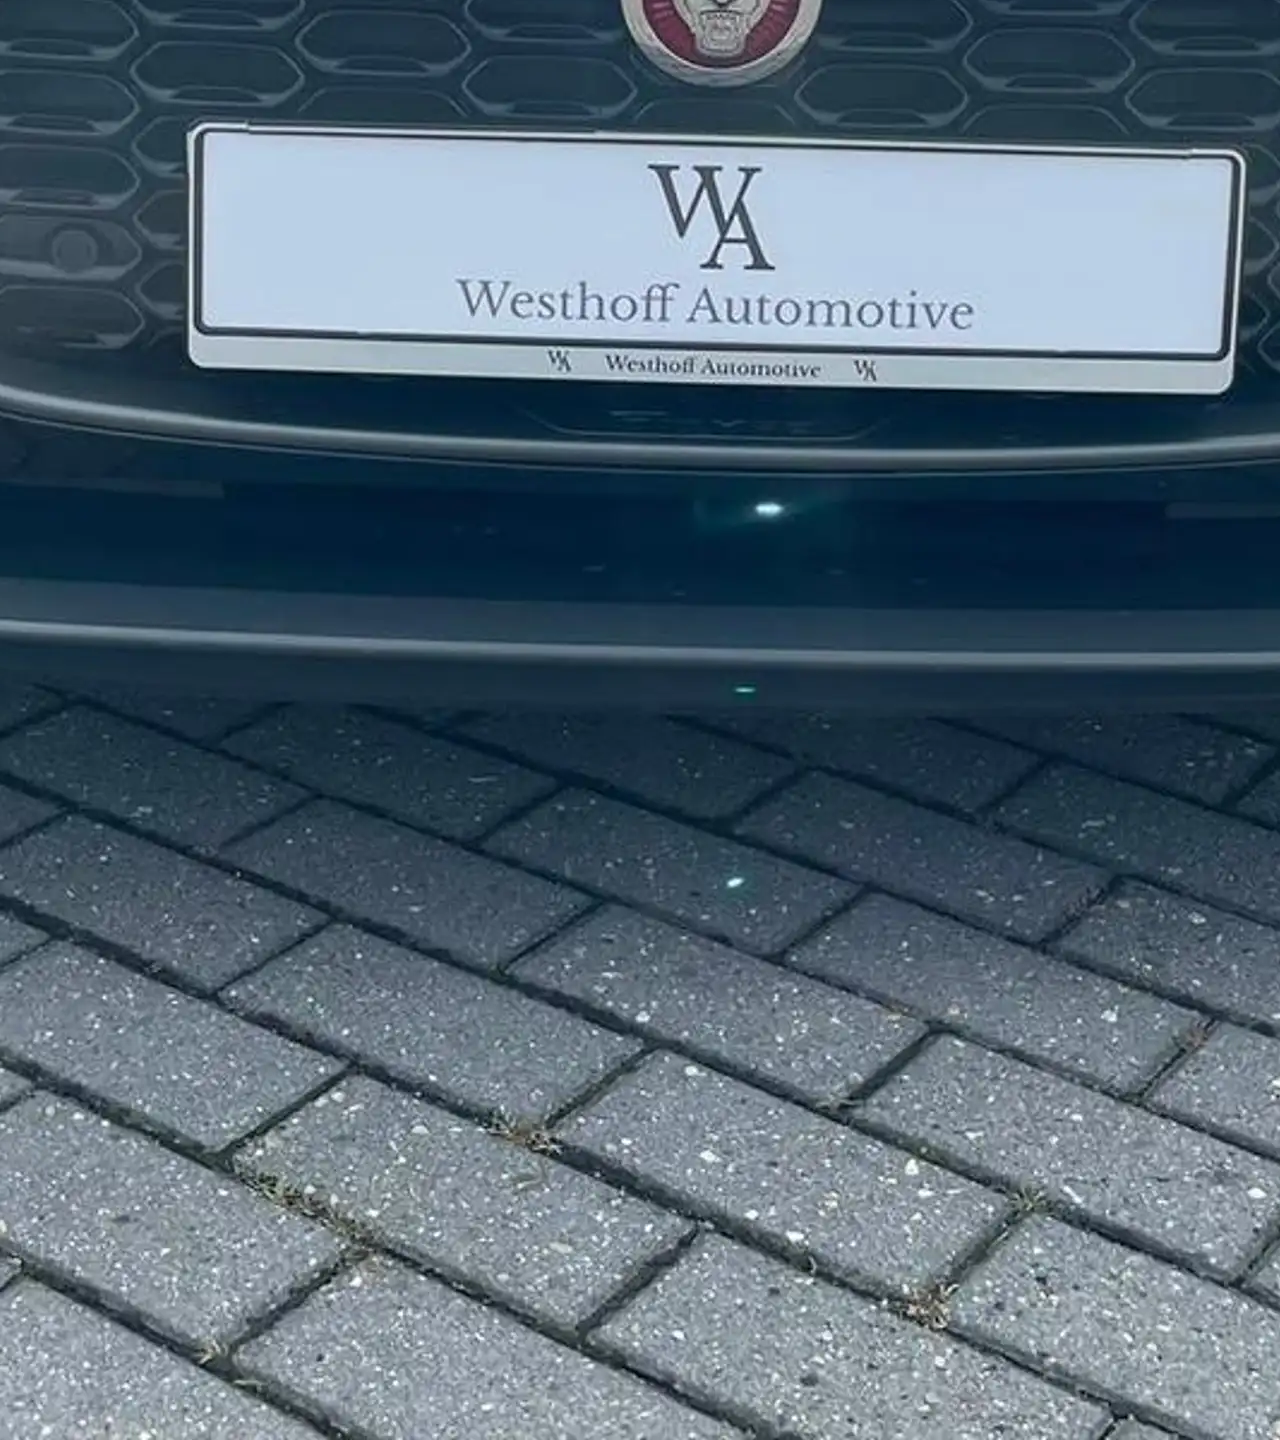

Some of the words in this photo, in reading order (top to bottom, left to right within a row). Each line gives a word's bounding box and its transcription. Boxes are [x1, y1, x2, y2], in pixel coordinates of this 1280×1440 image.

[647, 163, 776, 271] WA
[456, 278, 681, 323] Westhoff
[685, 287, 975, 331] Automotive
[605, 353, 695, 375] Westhoff
[700, 359, 822, 378] Automotive
